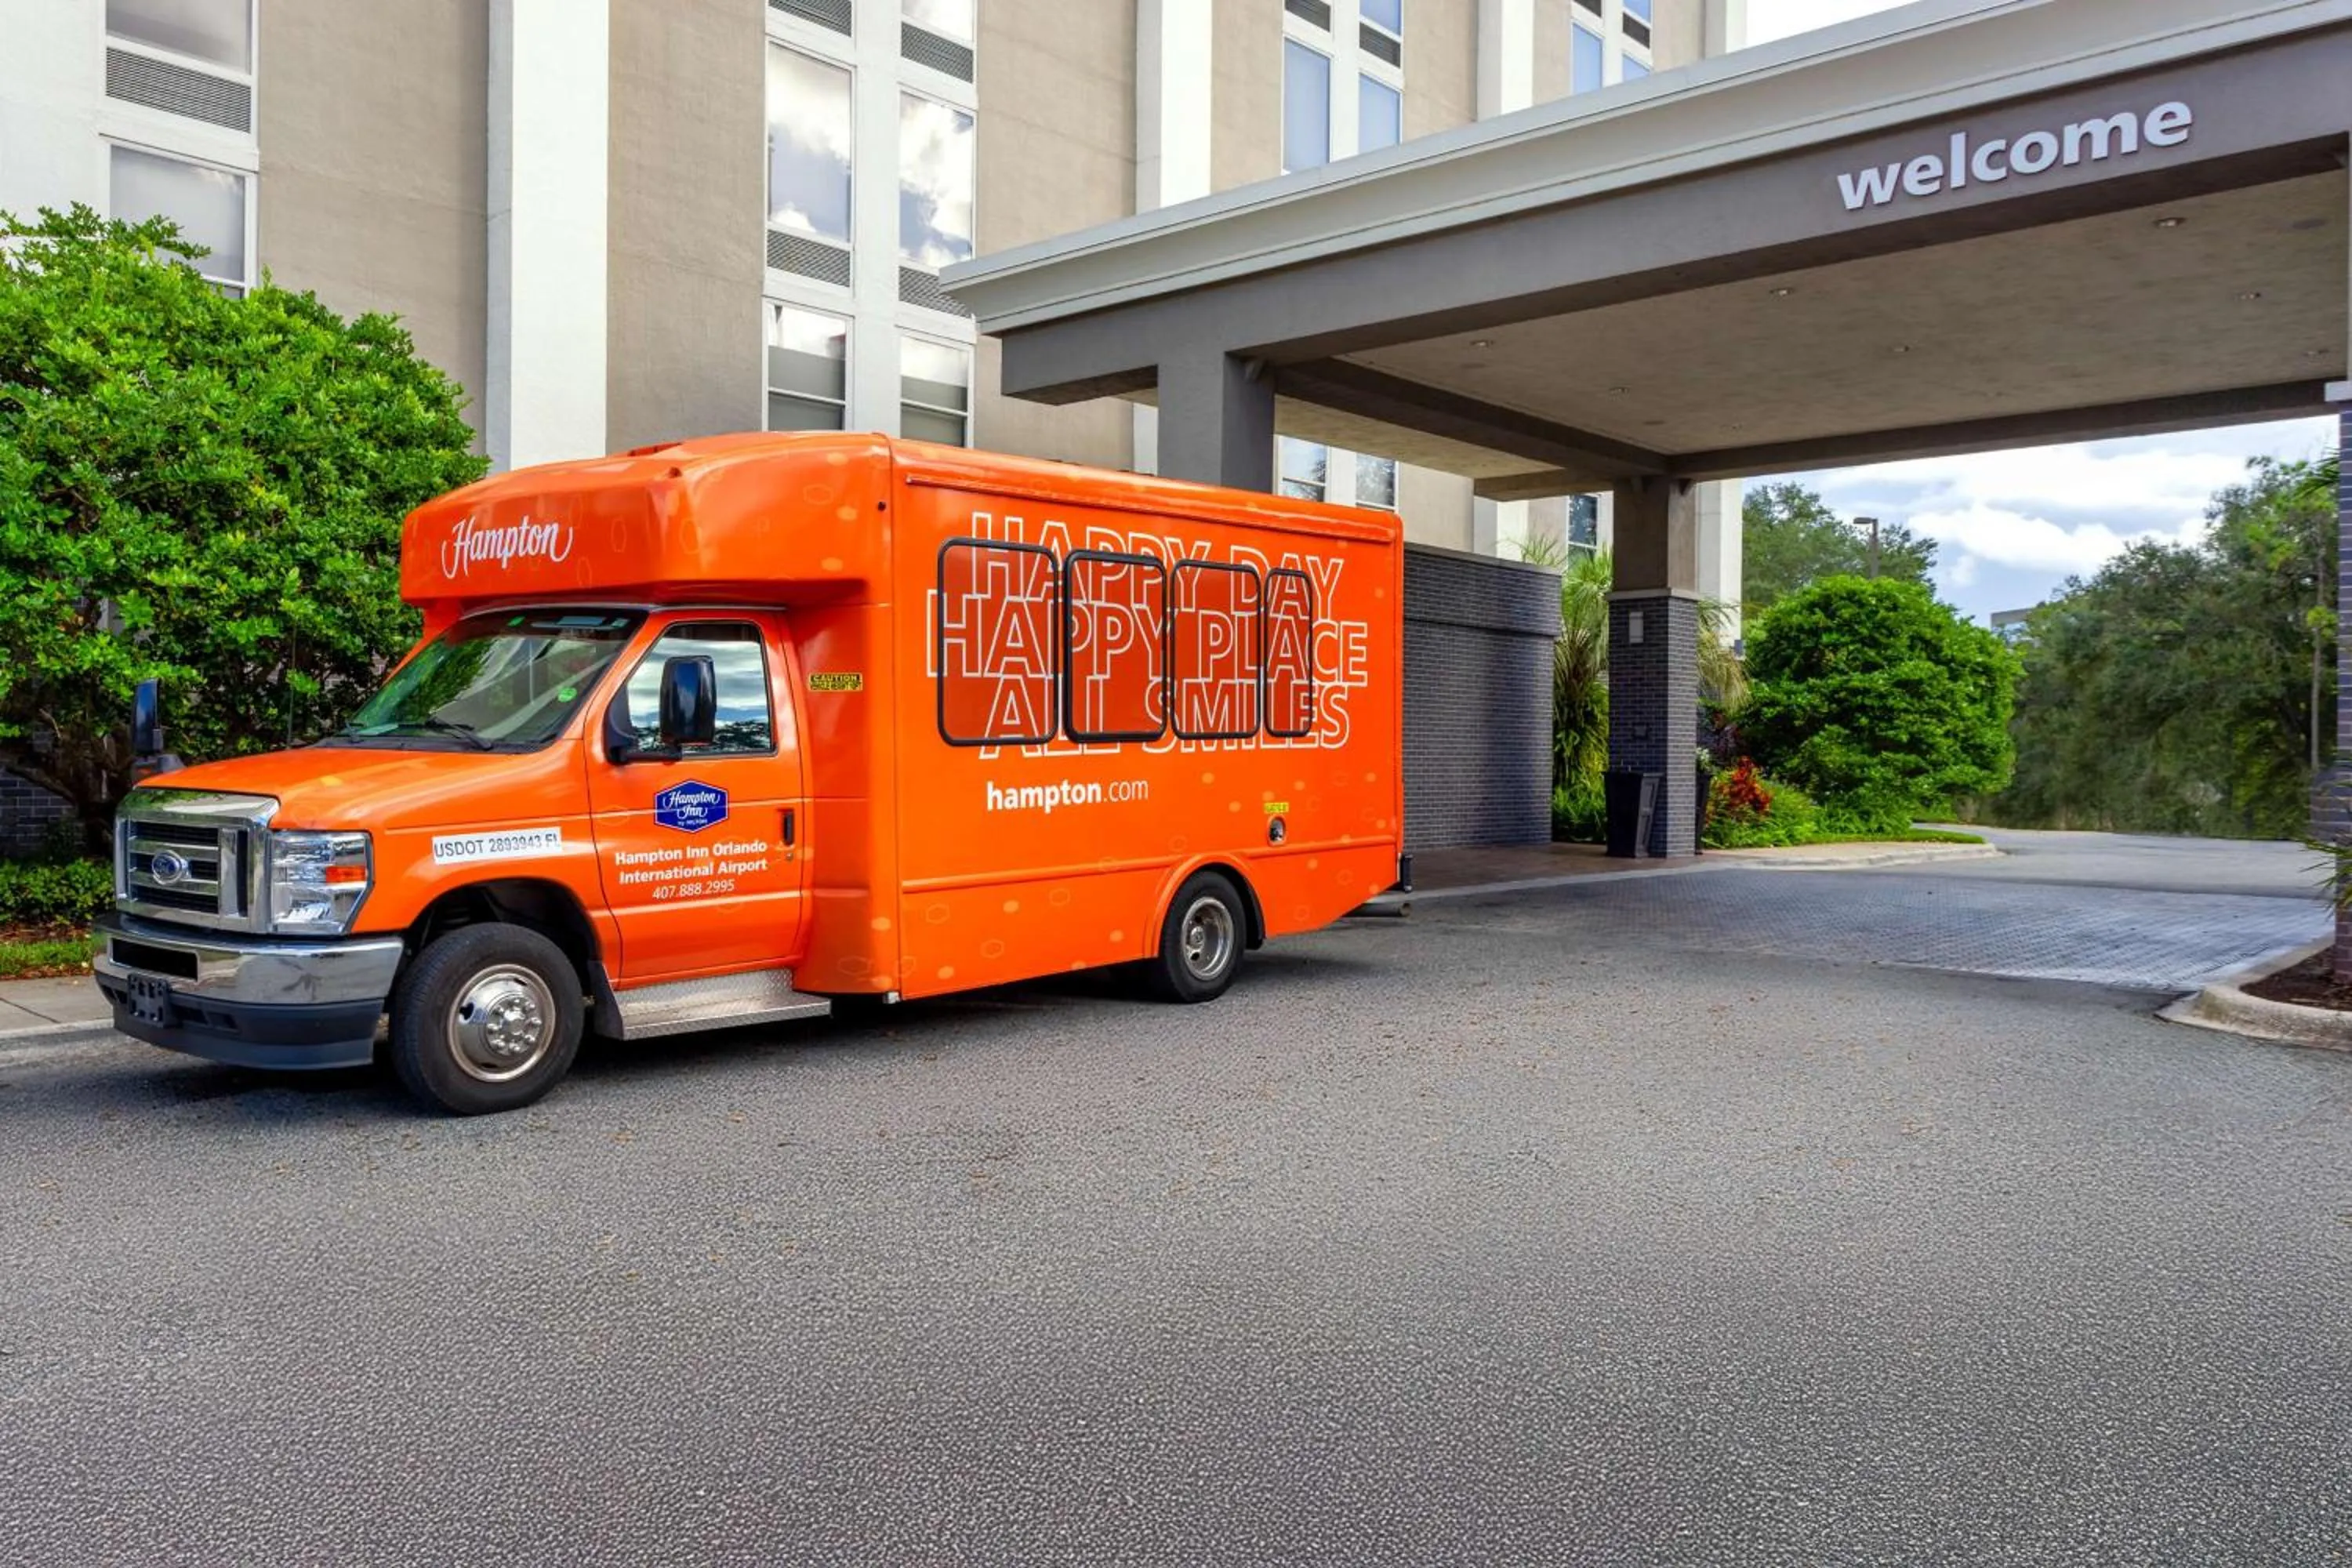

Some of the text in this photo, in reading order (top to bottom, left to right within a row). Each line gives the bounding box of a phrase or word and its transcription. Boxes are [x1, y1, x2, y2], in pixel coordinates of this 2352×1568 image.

[1837, 101, 2193, 210] welcome
[441, 515, 573, 579] Hampton
[971, 512, 1344, 620] HAPPY DAY
[926, 590, 1368, 686] HAPPY PLACE
[978, 675, 1350, 759] ALL SMILES
[662, 790, 720, 811] Hampton
[986, 779, 1149, 814] hampton.com
[677, 804, 708, 820] Inn
[434, 840, 484, 858] USDOT
[615, 840, 768, 866] Hampton Inn Orlando
[619, 858, 768, 884] International Airport
[652, 879, 735, 900] 407.888.2995
